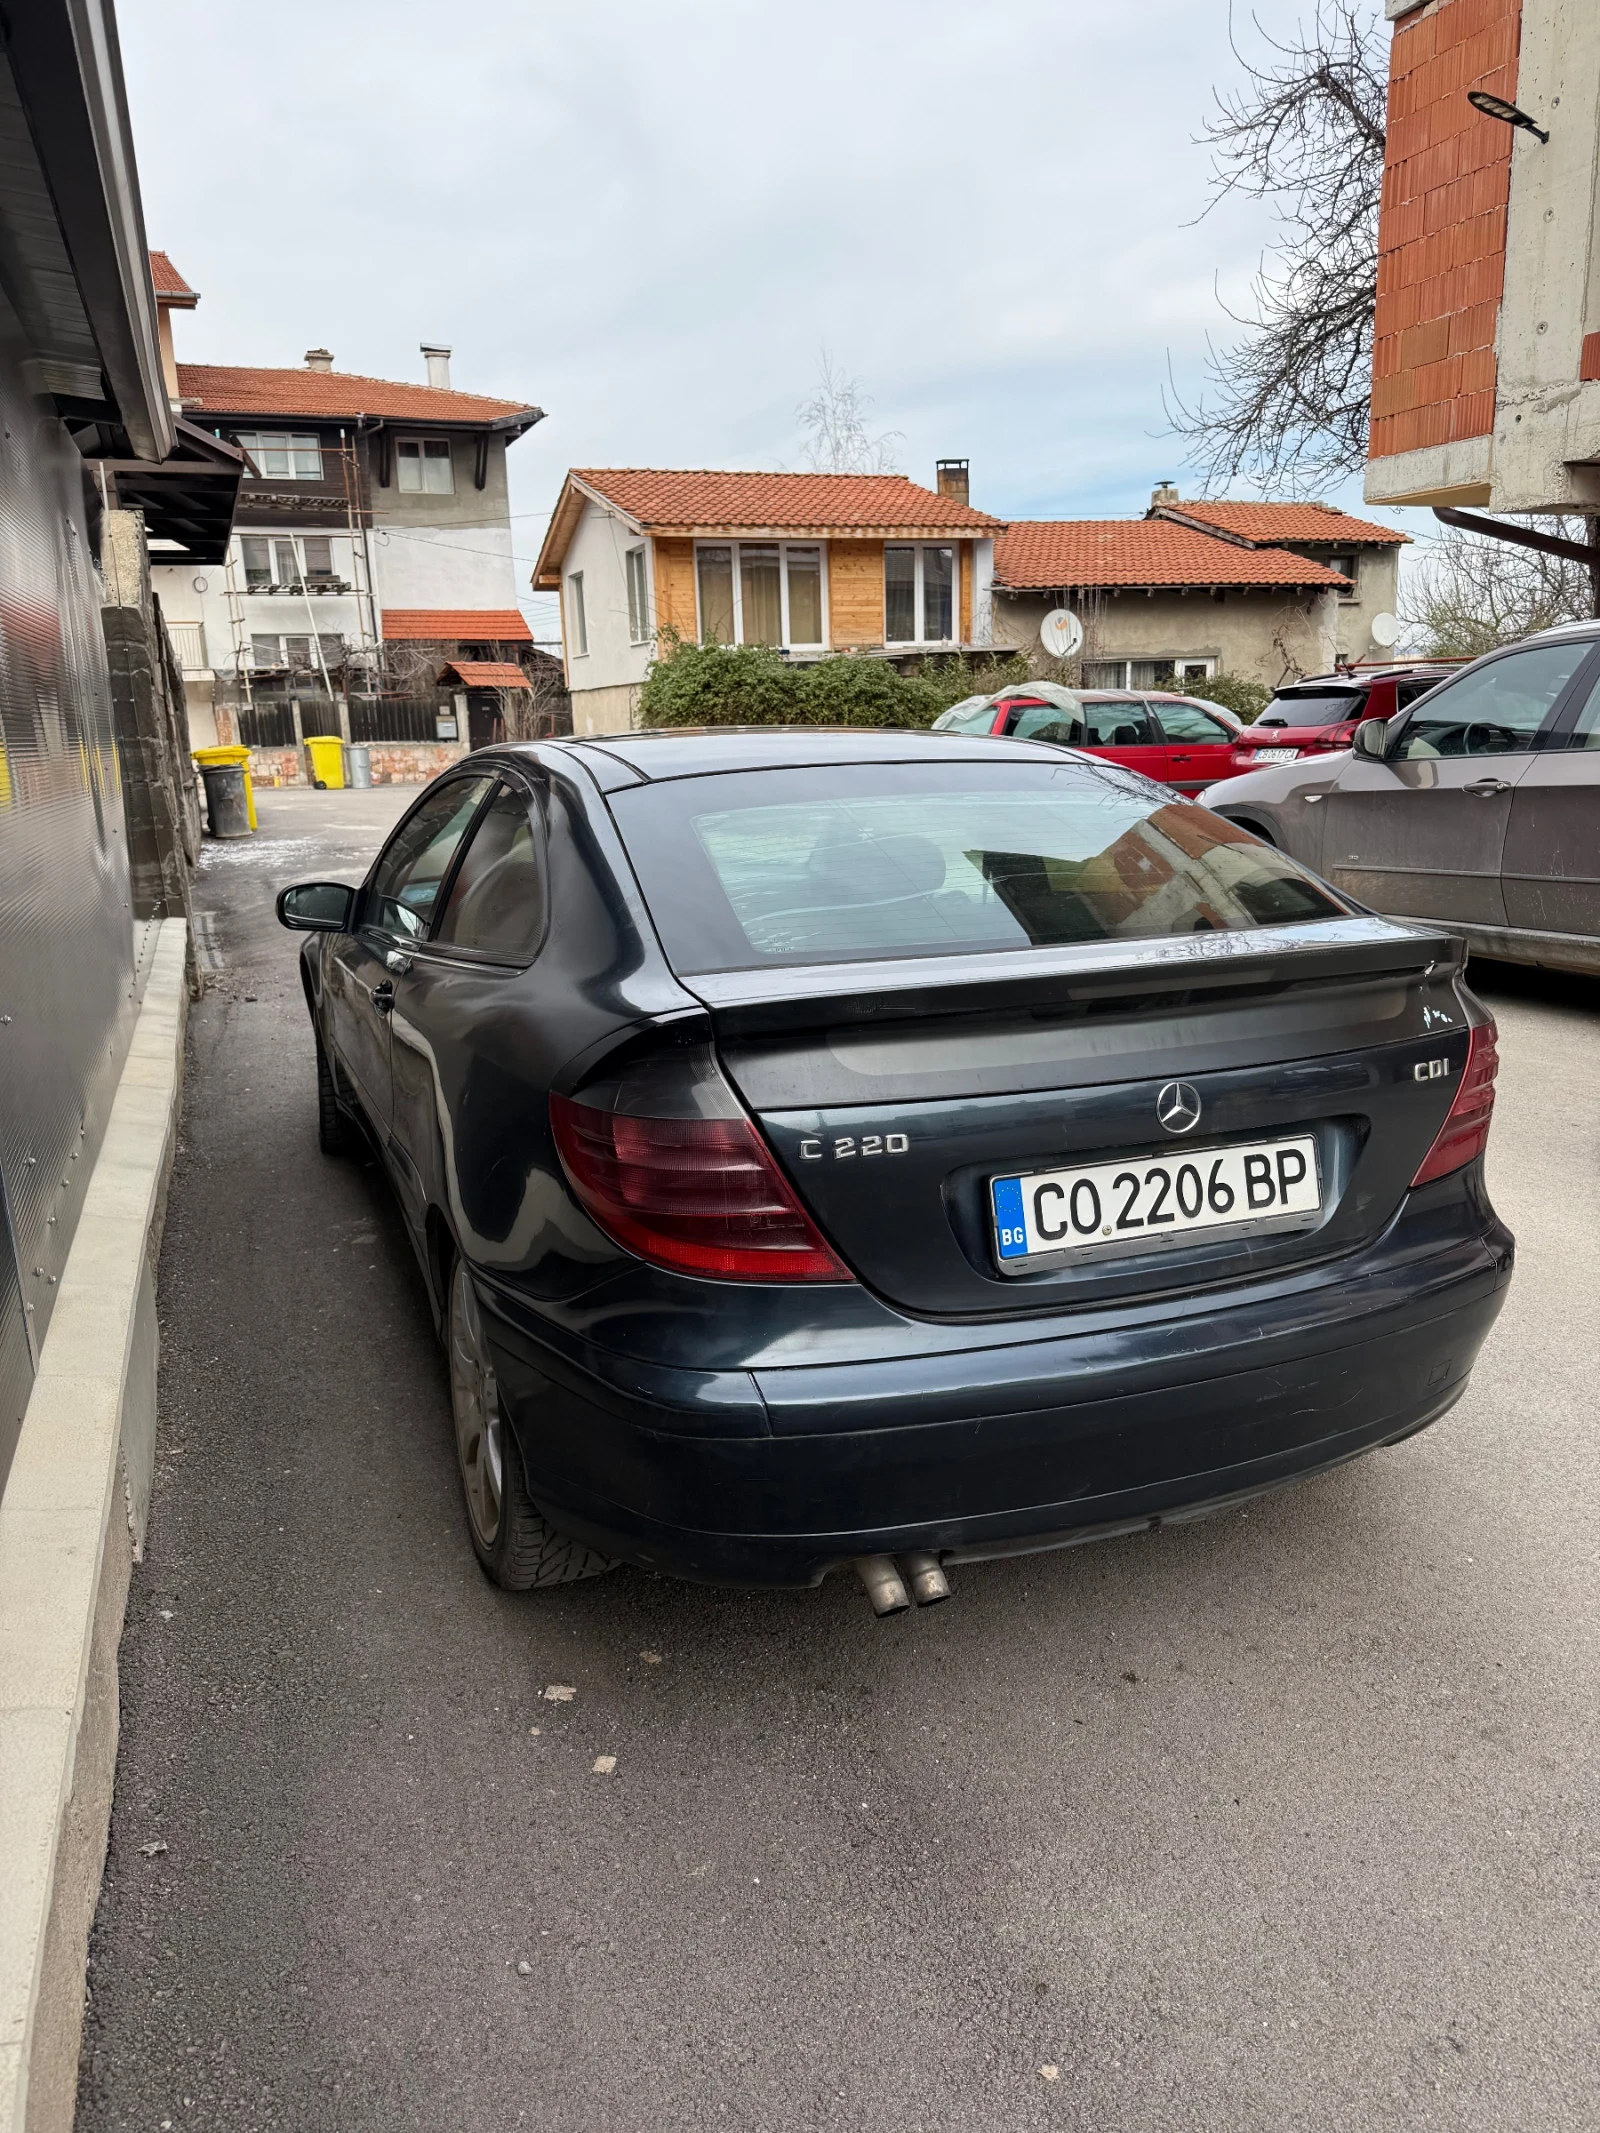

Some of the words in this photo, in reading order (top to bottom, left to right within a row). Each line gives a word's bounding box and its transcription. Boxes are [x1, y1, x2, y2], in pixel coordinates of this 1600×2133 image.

[1414, 1057, 1450, 1082] CDI
[800, 1140, 822, 1160] C
[833, 1134, 909, 1160] 220
[1112, 1158, 1235, 1230] 2206
[1243, 1148, 1307, 1210] BP
[1001, 1227, 1024, 1246] BG
